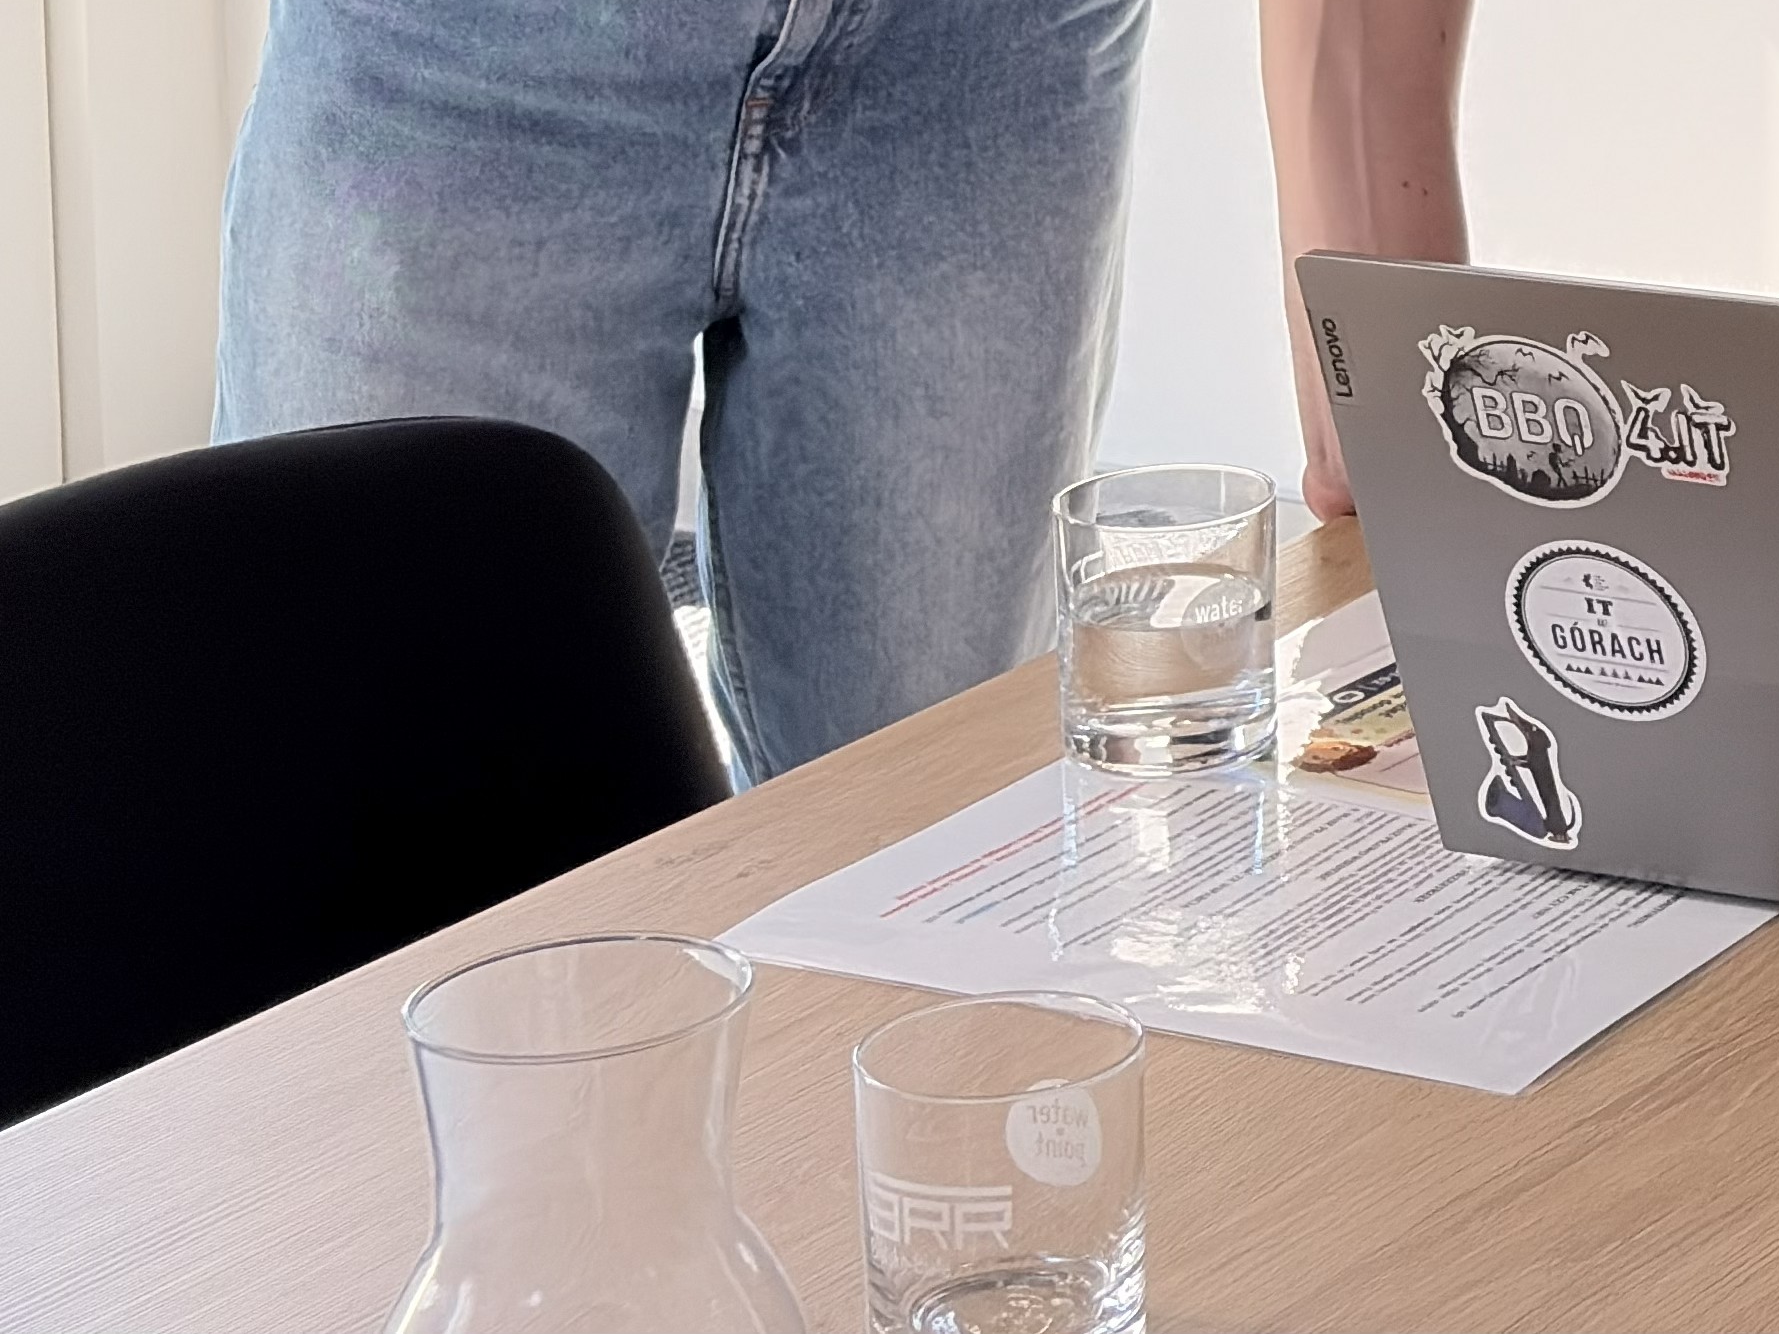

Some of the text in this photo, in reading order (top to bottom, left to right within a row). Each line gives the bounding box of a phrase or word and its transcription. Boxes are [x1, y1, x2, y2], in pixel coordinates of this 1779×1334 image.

[1321, 317, 1354, 399] Lenovo
[1471, 386, 1595, 457] BBQ
[1584, 596, 1613, 617] IT
[1551, 621, 1665, 665] GÓRACH
